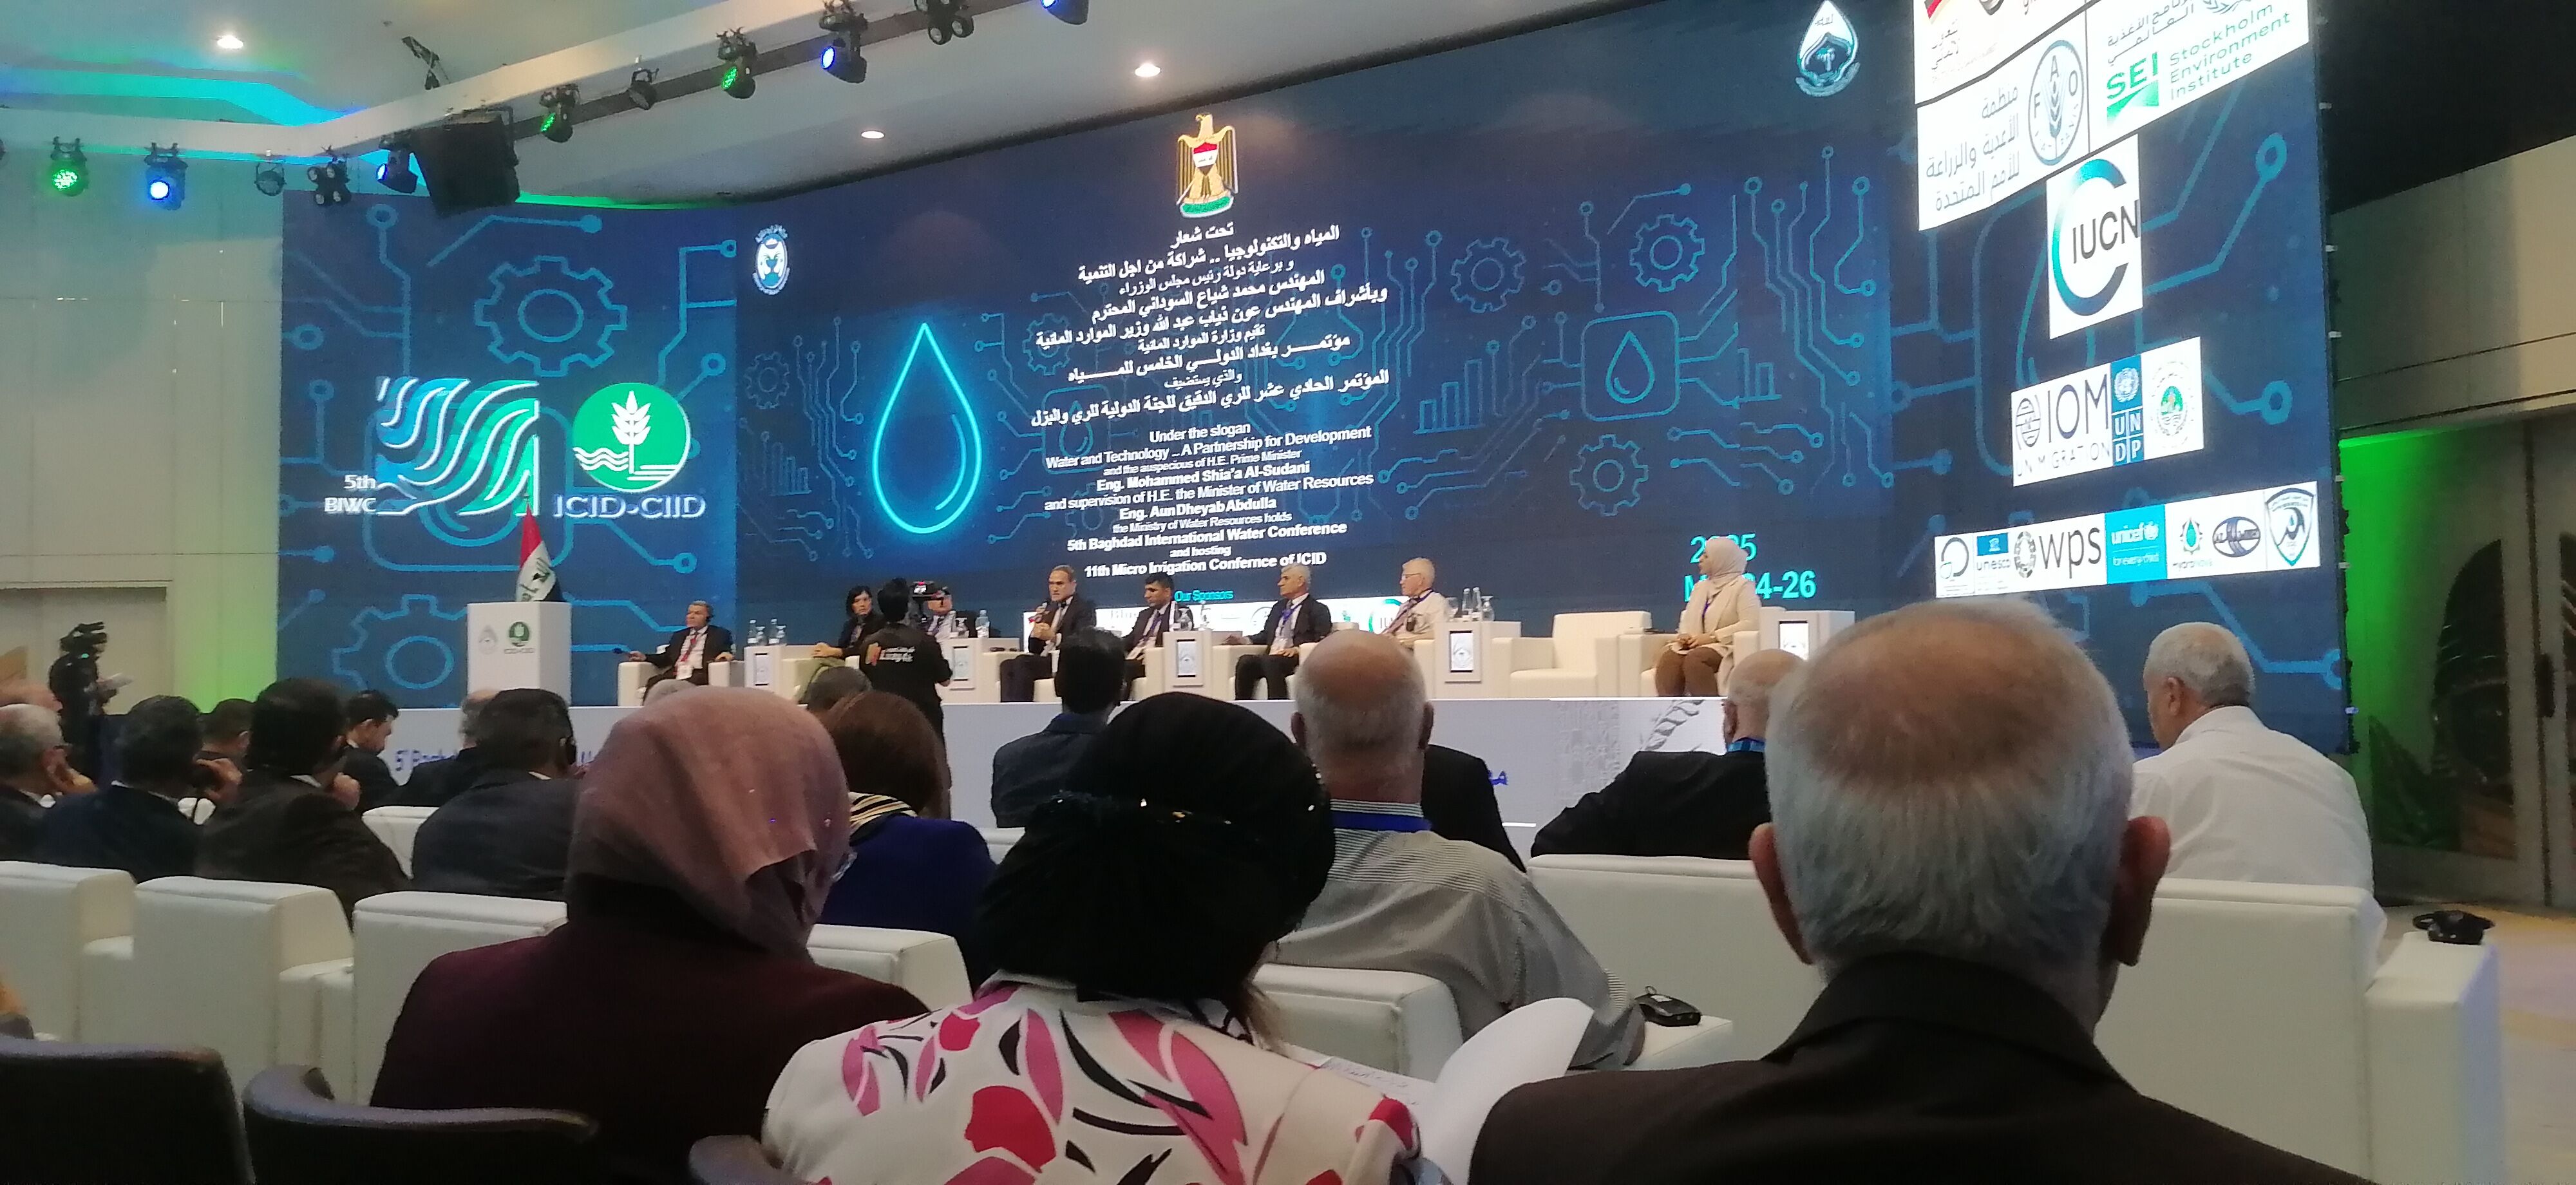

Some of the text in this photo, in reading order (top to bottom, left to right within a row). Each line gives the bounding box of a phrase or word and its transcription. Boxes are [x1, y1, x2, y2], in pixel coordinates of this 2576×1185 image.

[2170, 5, 2273, 66] Stockholm
[2171, 12, 2290, 83] Environment
[2107, 52, 2157, 99] SEI
[2171, 52, 2253, 100] Institute
[1982, 86, 2018, 118] منظمة
[1936, 170, 1985, 211] المتحدة
[1170, 222, 1234, 249] تحت شعار
[1304, 225, 1340, 247] المياه
[2073, 200, 2141, 264] IUCN
[1167, 248, 1206, 268] شراكة
[1224, 232, 1300, 261] والتكنولوجيا
[1078, 263, 1115, 284] التنمية
[1119, 259, 1142, 278] اجل
[1145, 259, 1164, 275] من
[1192, 269, 1221, 285] رئيس
[1223, 265, 1246, 280] دولة
[1119, 277, 1156, 296] الوزراء
[1159, 274, 1189, 290] مجلس
[1092, 269, 1325, 325] المهندس محمد شياع السوداني المحترم
[1036, 282, 1388, 350] وبأشراف المهندس عون ذياب عبد الله وزير الموارد المائية
[1138, 323, 1265, 354] تقيم وزارة الموارد المائية
[1247, 341, 1278, 359] بغداد
[1135, 354, 1182, 376] الخامس
[1164, 368, 1242, 390] والذي يستضيف
[1030, 368, 1388, 426] المؤتمر الحادي عشر للري الدقيق للجنة الدولية للري والبزل
[2047, 374, 2109, 443] IOM
[1150, 423, 1251, 443] Under the slogan
[2114, 409, 2141, 436] UN
[1045, 455, 1079, 469] Water
[1081, 451, 1103, 465] and
[1103, 447, 1170, 464] Technology
[1180, 444, 1192, 456] A
[1193, 437, 1262, 455] Partnership
[1265, 435, 1283, 448] for
[1285, 425, 1372, 446] Development
[2038, 441, 2110, 469] MGRATON
[2116, 438, 2141, 462] DP
[1103, 465, 1122, 476] and
[1123, 464, 1139, 475] the
[1195, 457, 1207, 468] of
[1208, 455, 1229, 467] H.E.
[1231, 452, 1260, 465] Prime
[1261, 449, 1302, 462] Minister
[343, 473, 376, 490] 5th
[1097, 460, 1311, 493] Eng. Mohammed Shia'a Al-Sudani
[324, 497, 377, 513] BIWC
[552, 493, 706, 519] ICID-CIID
[1044, 474, 1374, 511] and supervision of H.E. the Minister of Water Resources
[1113, 511, 1292, 533] the Ministry of Water Resources holds
[1119, 497, 1276, 521] Eng. Aun Dheyab Abdulla
[1067, 523, 1347, 551] 5th Baghdad International Water Conference
[1690, 533, 1757, 564] 25
[1084, 551, 1327, 578] 11th Micro Irrigation Confernce of ICID
[1170, 545, 1231, 558] and hosting
[2038, 527, 2101, 579] wps
[1174, 589, 1235, 603] Our Sponsors
[1742, 570, 1817, 599] 4-26
